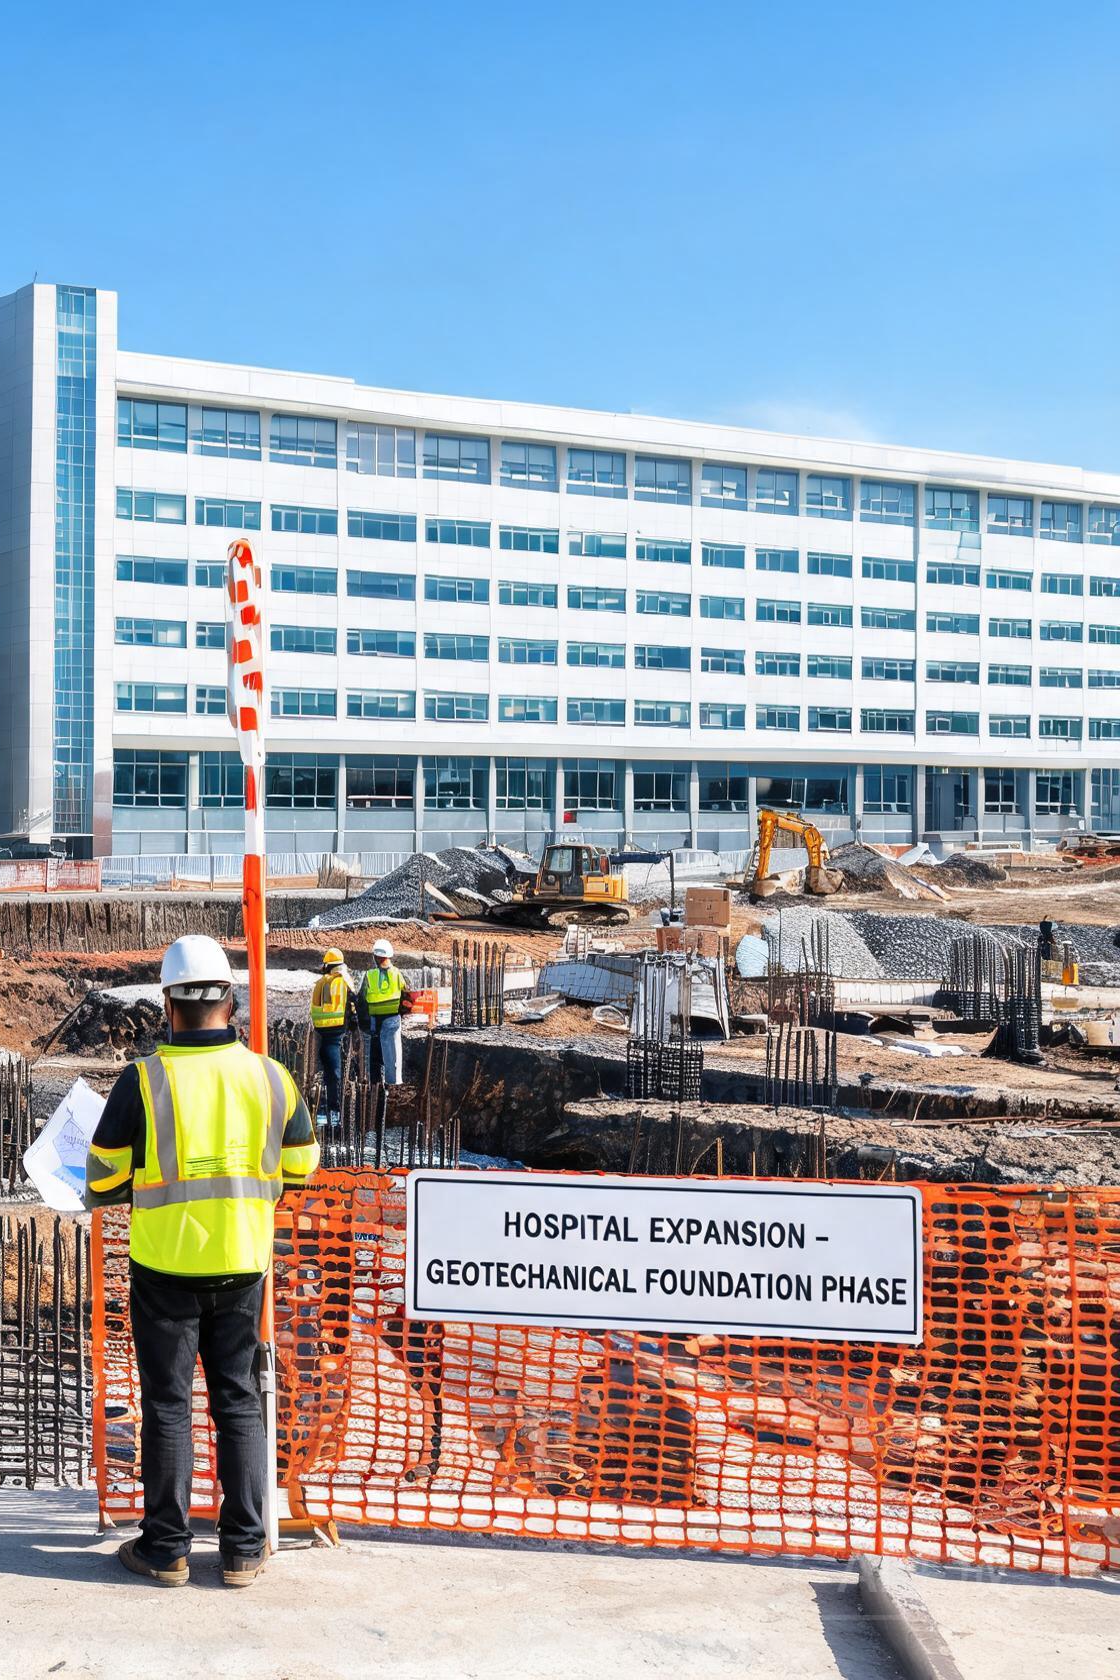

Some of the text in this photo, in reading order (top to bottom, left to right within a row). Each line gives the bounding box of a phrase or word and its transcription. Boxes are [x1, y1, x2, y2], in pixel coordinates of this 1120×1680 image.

[504, 1211, 639, 1243] HOSPITAL
[649, 1217, 805, 1249] EXPANSION
[426, 1258, 907, 1306] GEOTECHANICAL FOUNDATION PHASE
